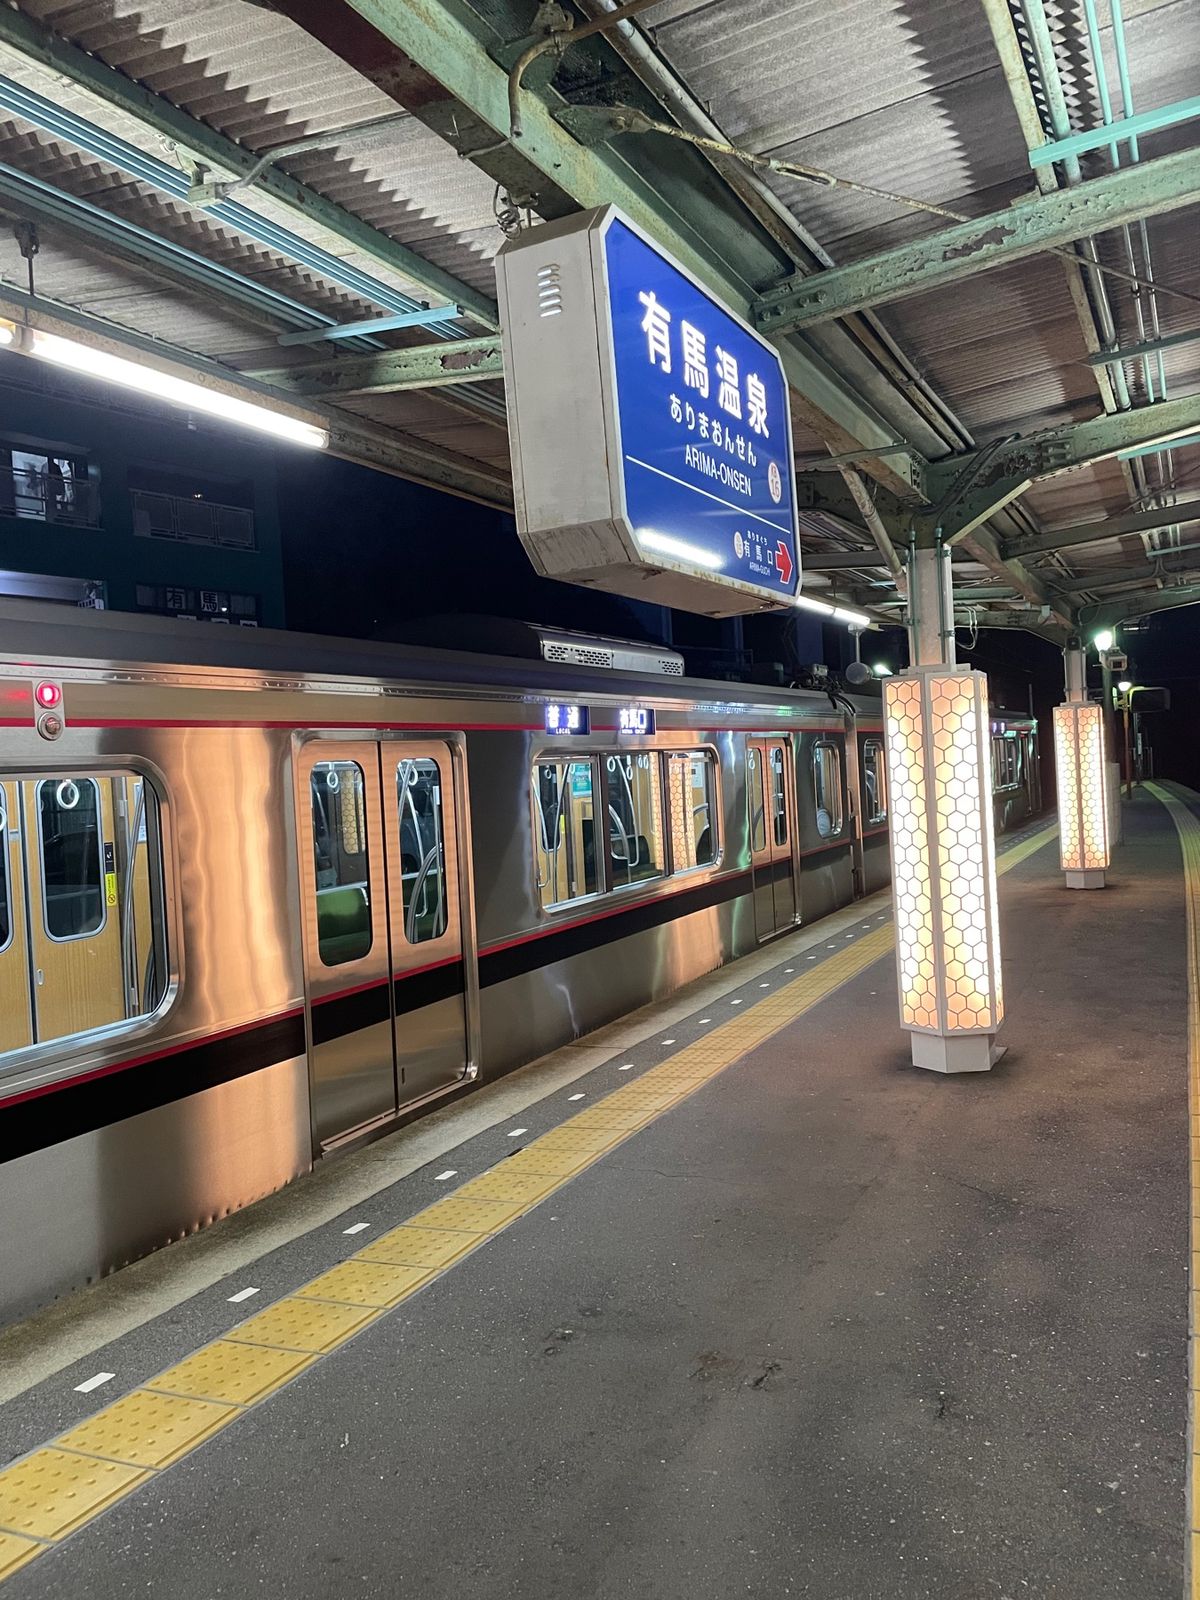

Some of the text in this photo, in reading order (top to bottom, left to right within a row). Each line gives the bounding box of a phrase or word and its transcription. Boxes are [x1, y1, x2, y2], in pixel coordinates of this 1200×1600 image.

[638, 290, 770, 438] 有馬温泉
[669, 393, 757, 467] ありまおんせん
[684, 444, 752, 497] ARIMA-ONSEN
[771, 478, 780, 498] 16
[743, 540, 774, 566] 有馬口
[168, 587, 218, 612] 有馬
[548, 705, 579, 728] 普通
